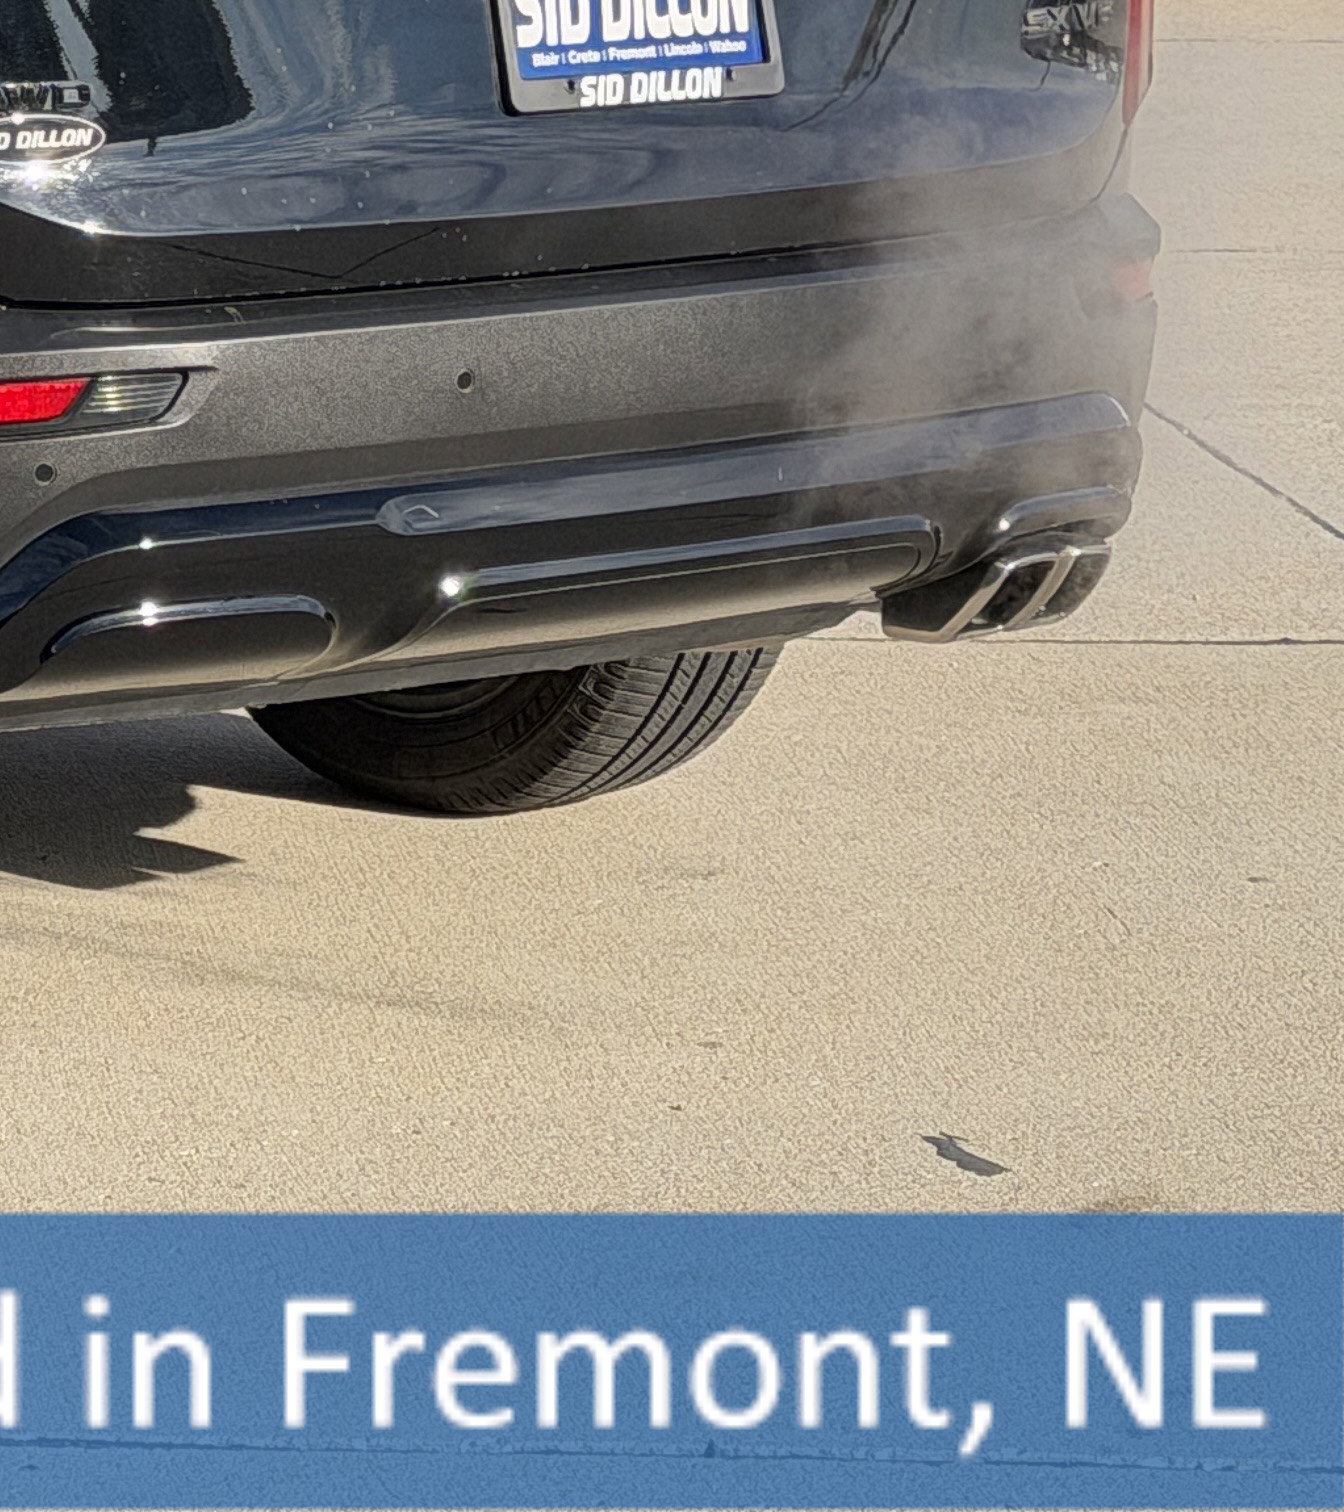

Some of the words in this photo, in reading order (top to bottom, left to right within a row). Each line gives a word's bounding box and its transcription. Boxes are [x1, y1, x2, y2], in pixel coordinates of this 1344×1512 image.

[567, 49, 602, 65] Crete
[608, 44, 658, 61] Fremont
[579, 72, 625, 108] SID
[630, 66, 724, 104] DILLON
[15, 128, 94, 150] DILLON
